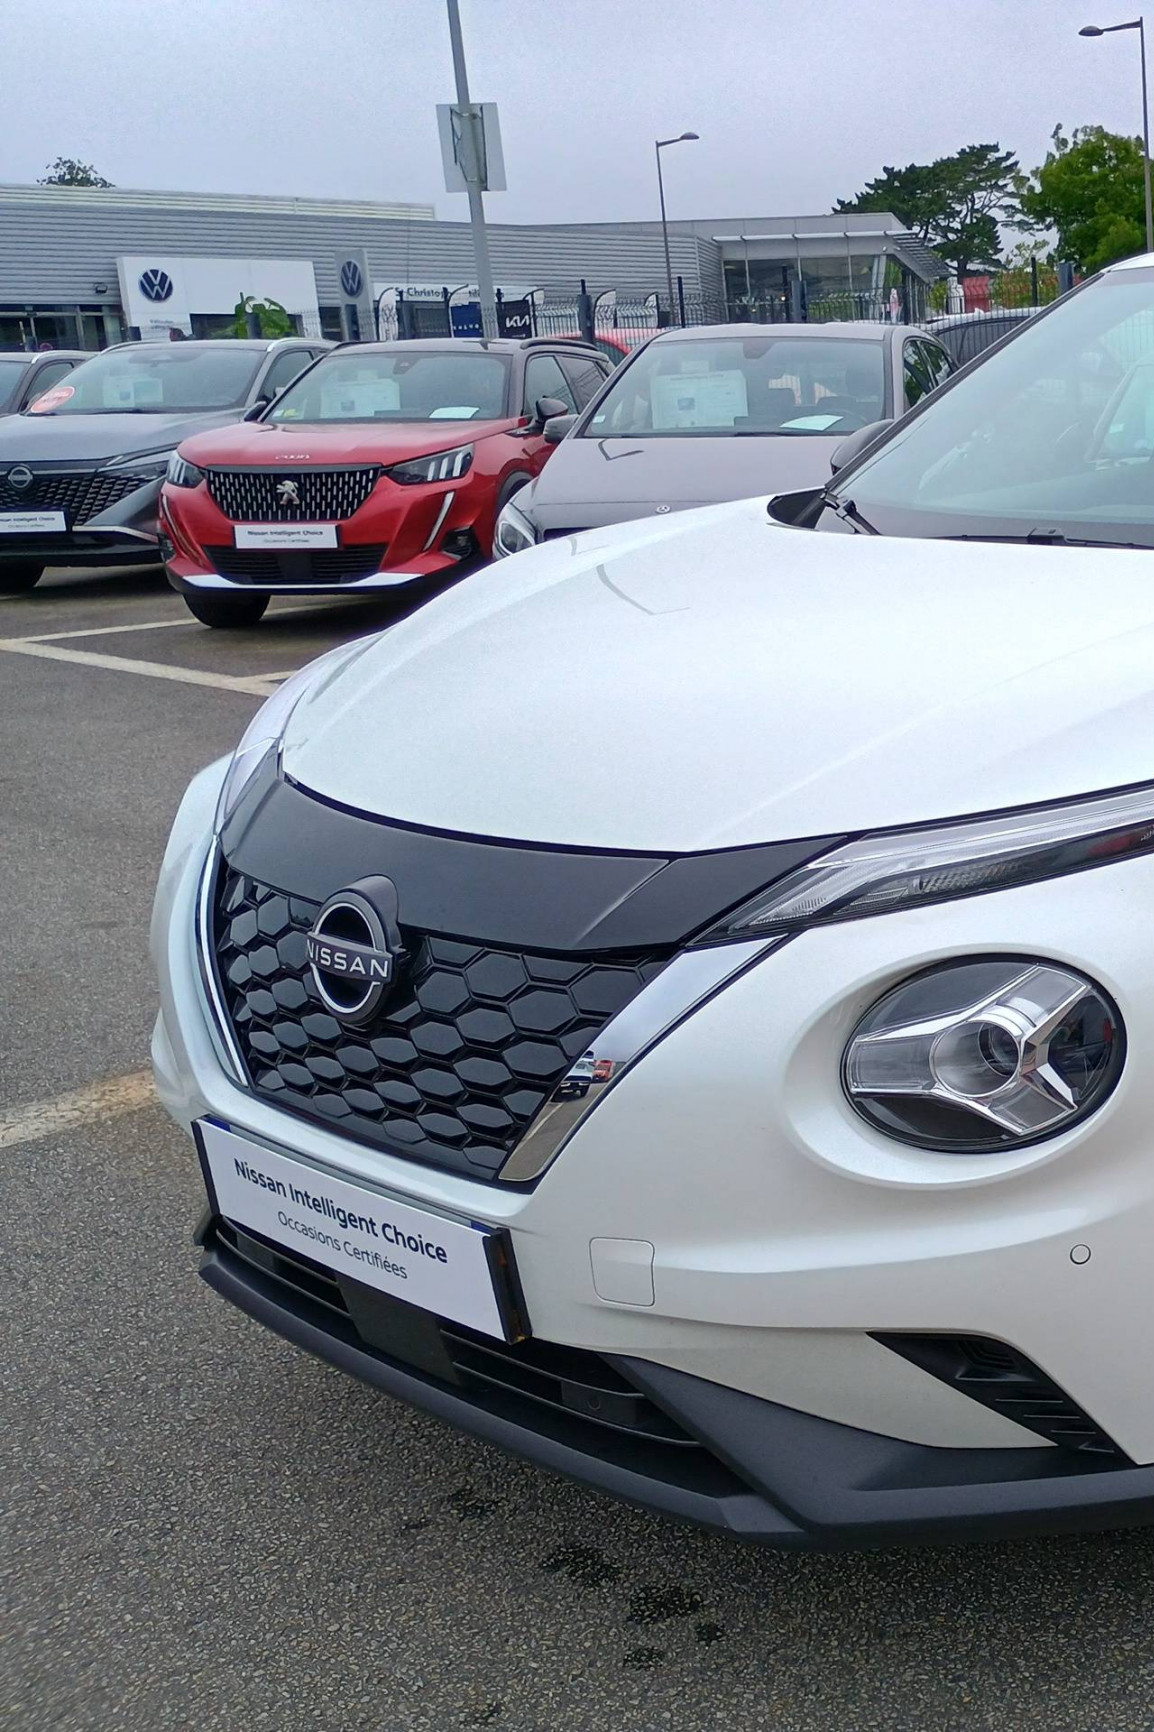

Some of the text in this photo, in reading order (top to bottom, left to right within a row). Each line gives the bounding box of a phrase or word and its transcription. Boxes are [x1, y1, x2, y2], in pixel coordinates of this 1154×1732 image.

[306, 938, 389, 978] NISSAN
[233, 1157, 448, 1264] Nissan Intelligent Choice
[277, 1211, 408, 1280] Occasions Certifiées
